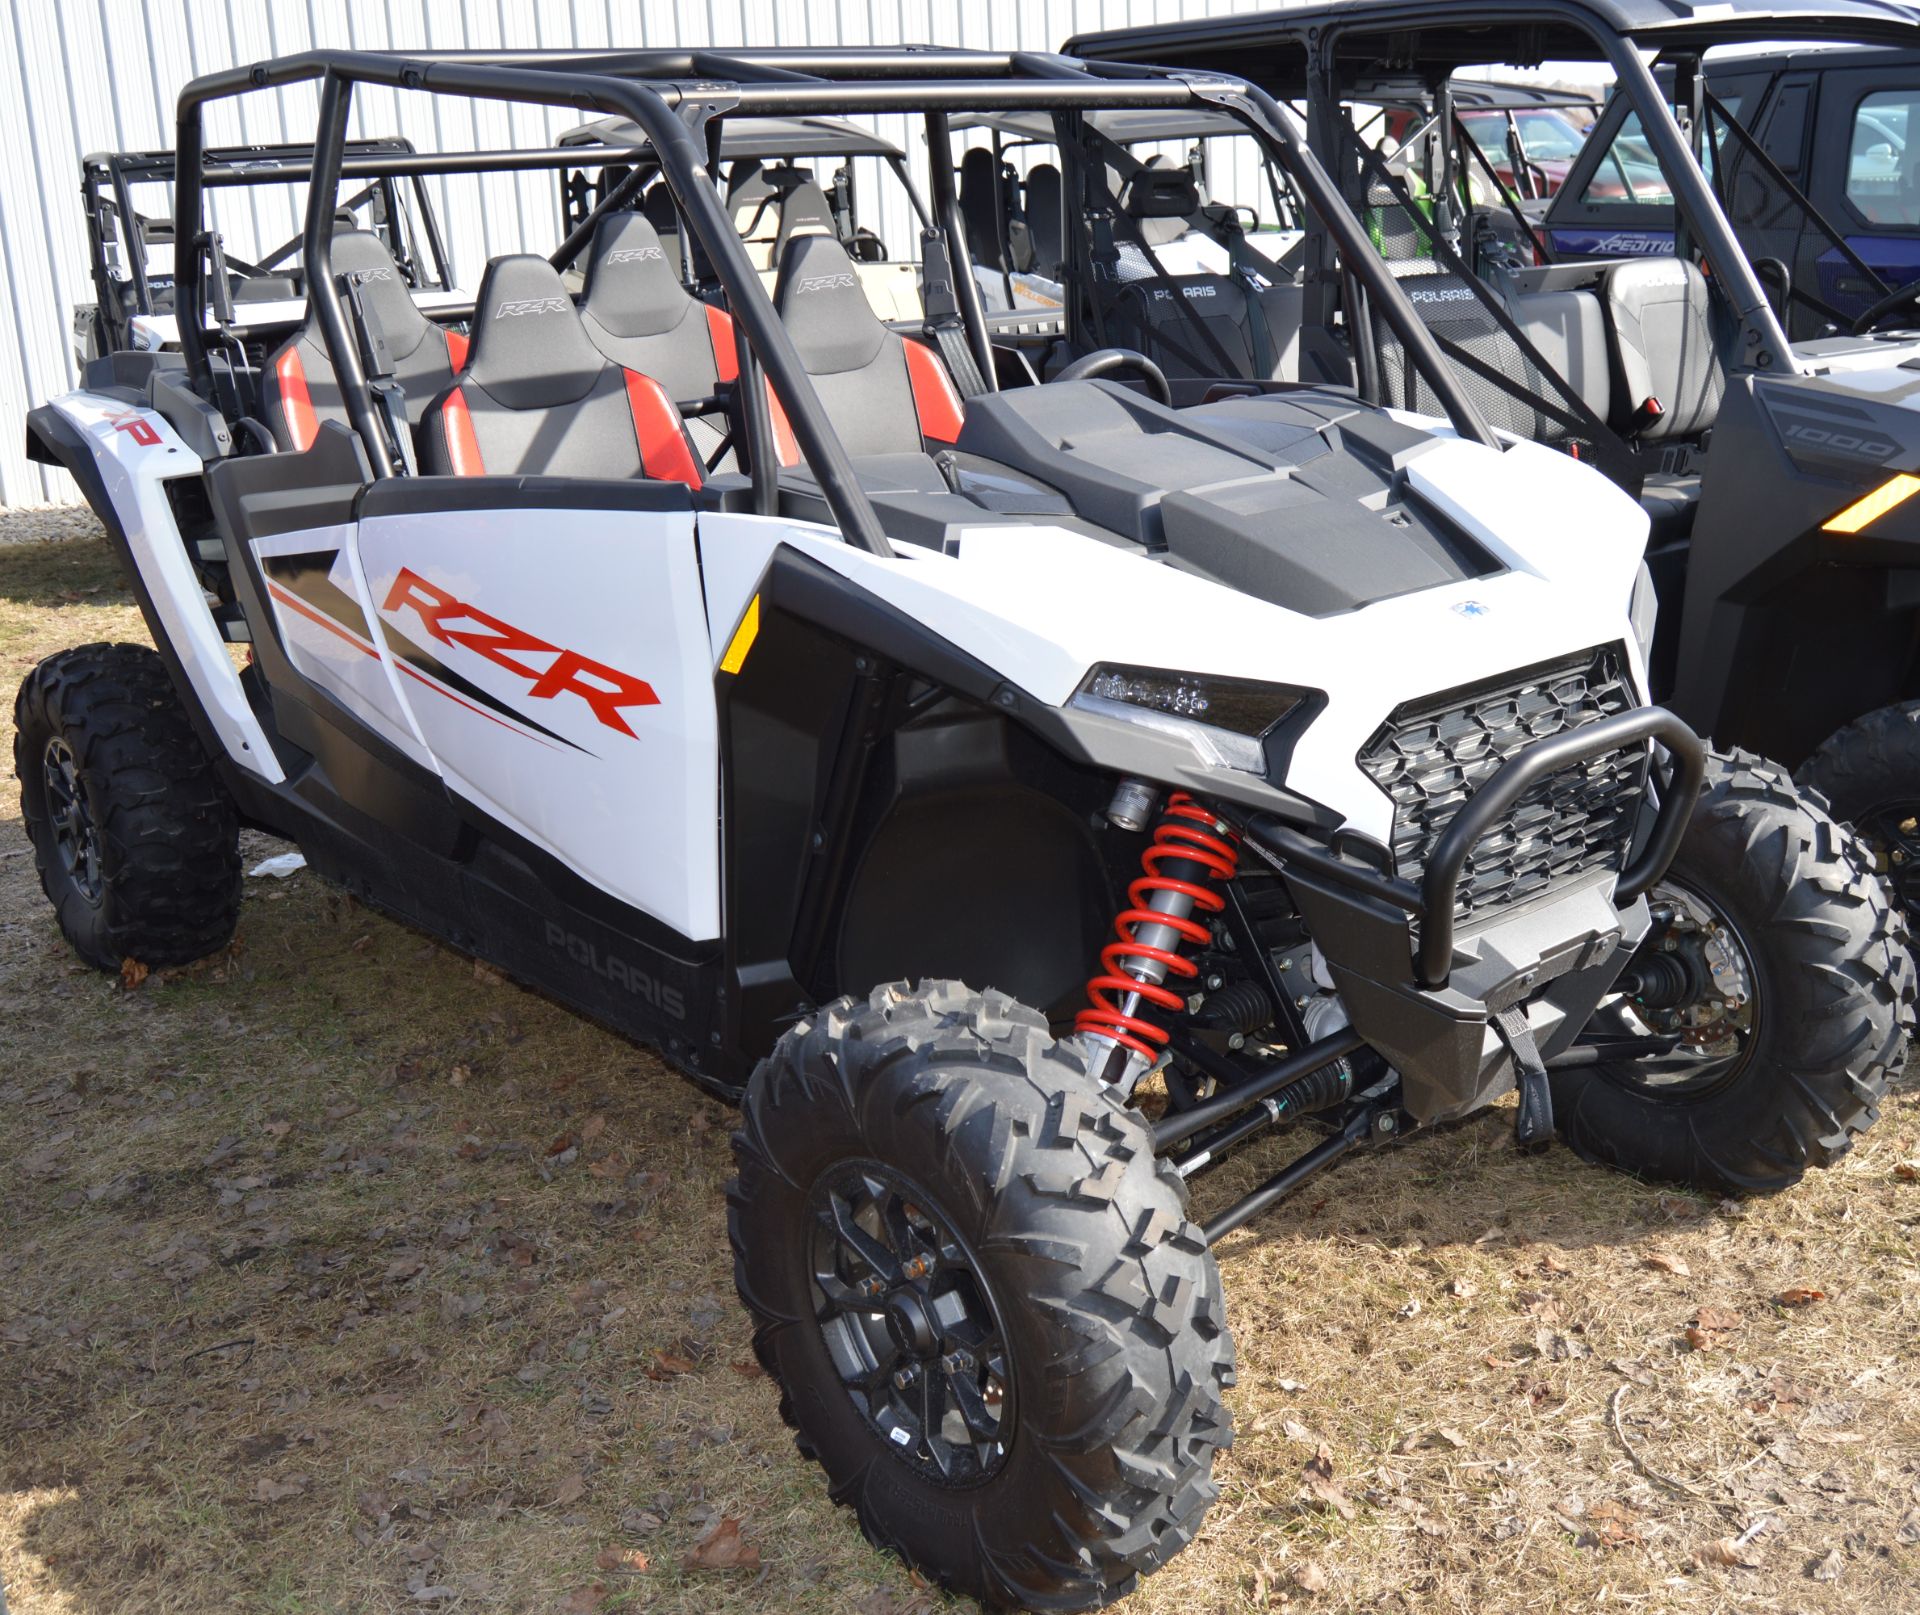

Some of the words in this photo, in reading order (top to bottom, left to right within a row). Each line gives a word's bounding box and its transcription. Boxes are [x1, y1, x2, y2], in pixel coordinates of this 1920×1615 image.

[1588, 233, 1676, 254] XPEDITIO
[606, 246, 663, 265] RZR
[147, 280, 175, 289] POLA
[333, 267, 392, 283] ZR
[796, 273, 855, 294] RZR
[1153, 285, 1217, 300] POARIS
[1411, 288, 1475, 303] POLARIS
[495, 297, 568, 319] RZR
[101, 408, 164, 447] XP
[1785, 424, 1897, 457] 1000
[382, 565, 662, 742] RZR
[544, 919, 686, 1021] POLARIS
